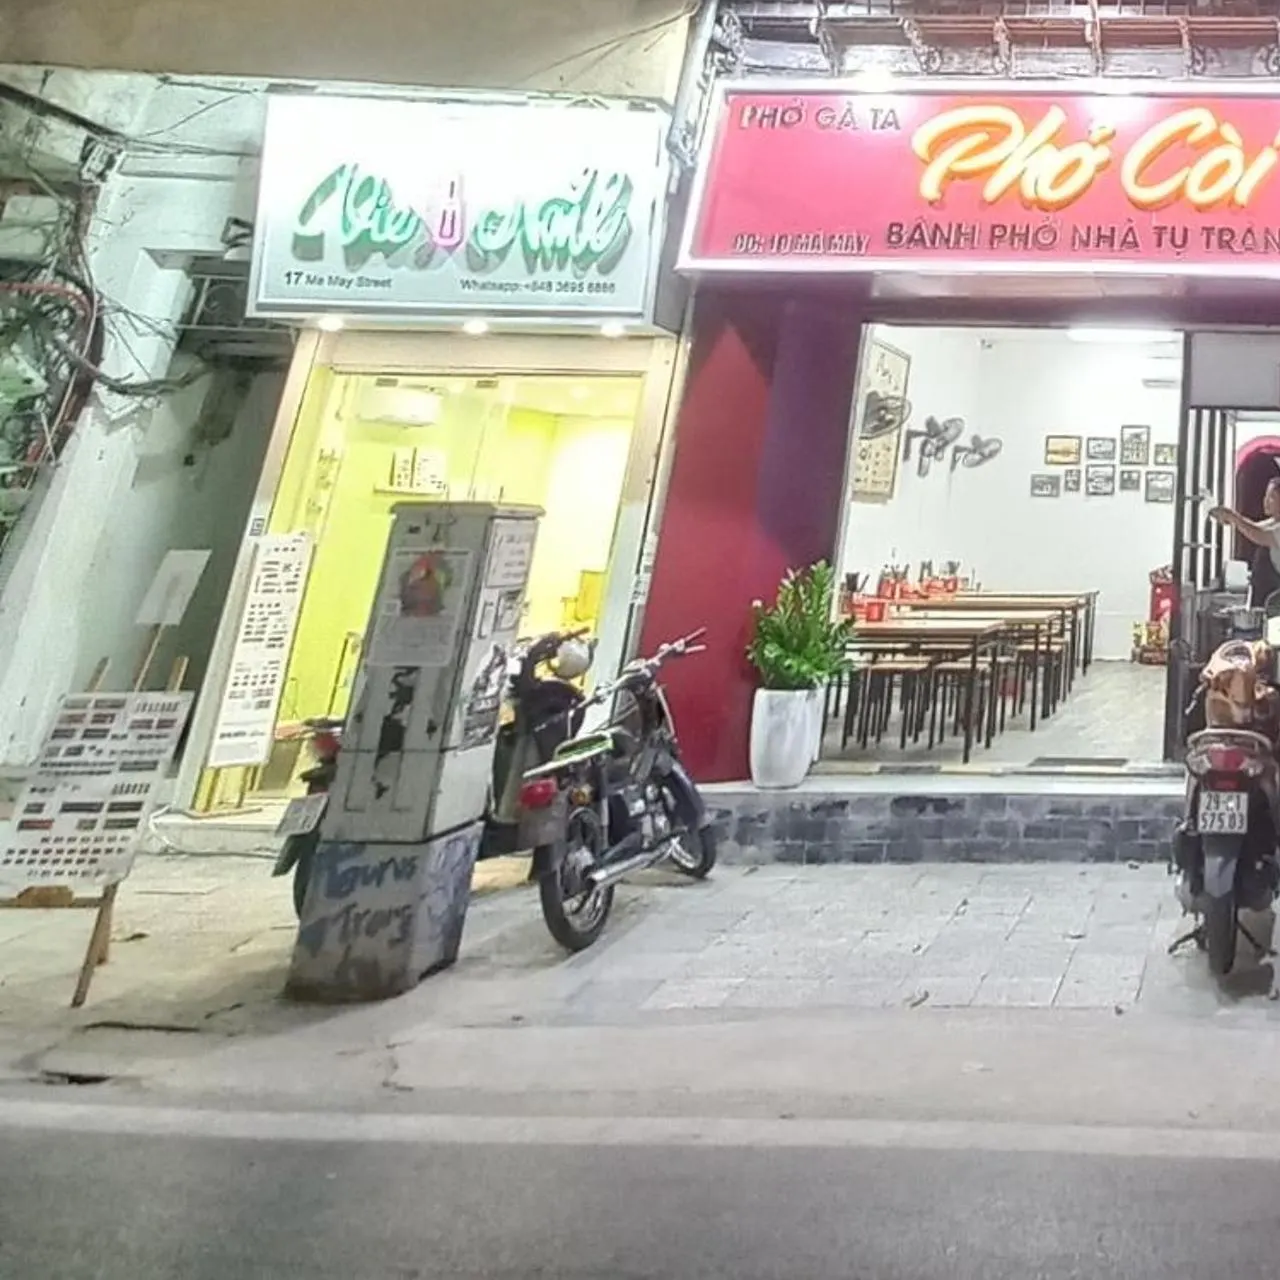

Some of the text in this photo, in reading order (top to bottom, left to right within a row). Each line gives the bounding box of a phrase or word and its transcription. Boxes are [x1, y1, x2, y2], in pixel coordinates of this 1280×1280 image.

[869, 107, 901, 130] TA
[910, 104, 1116, 213] Phở
[284, 270, 303, 286] 17
[355, 276, 392, 289] Street
